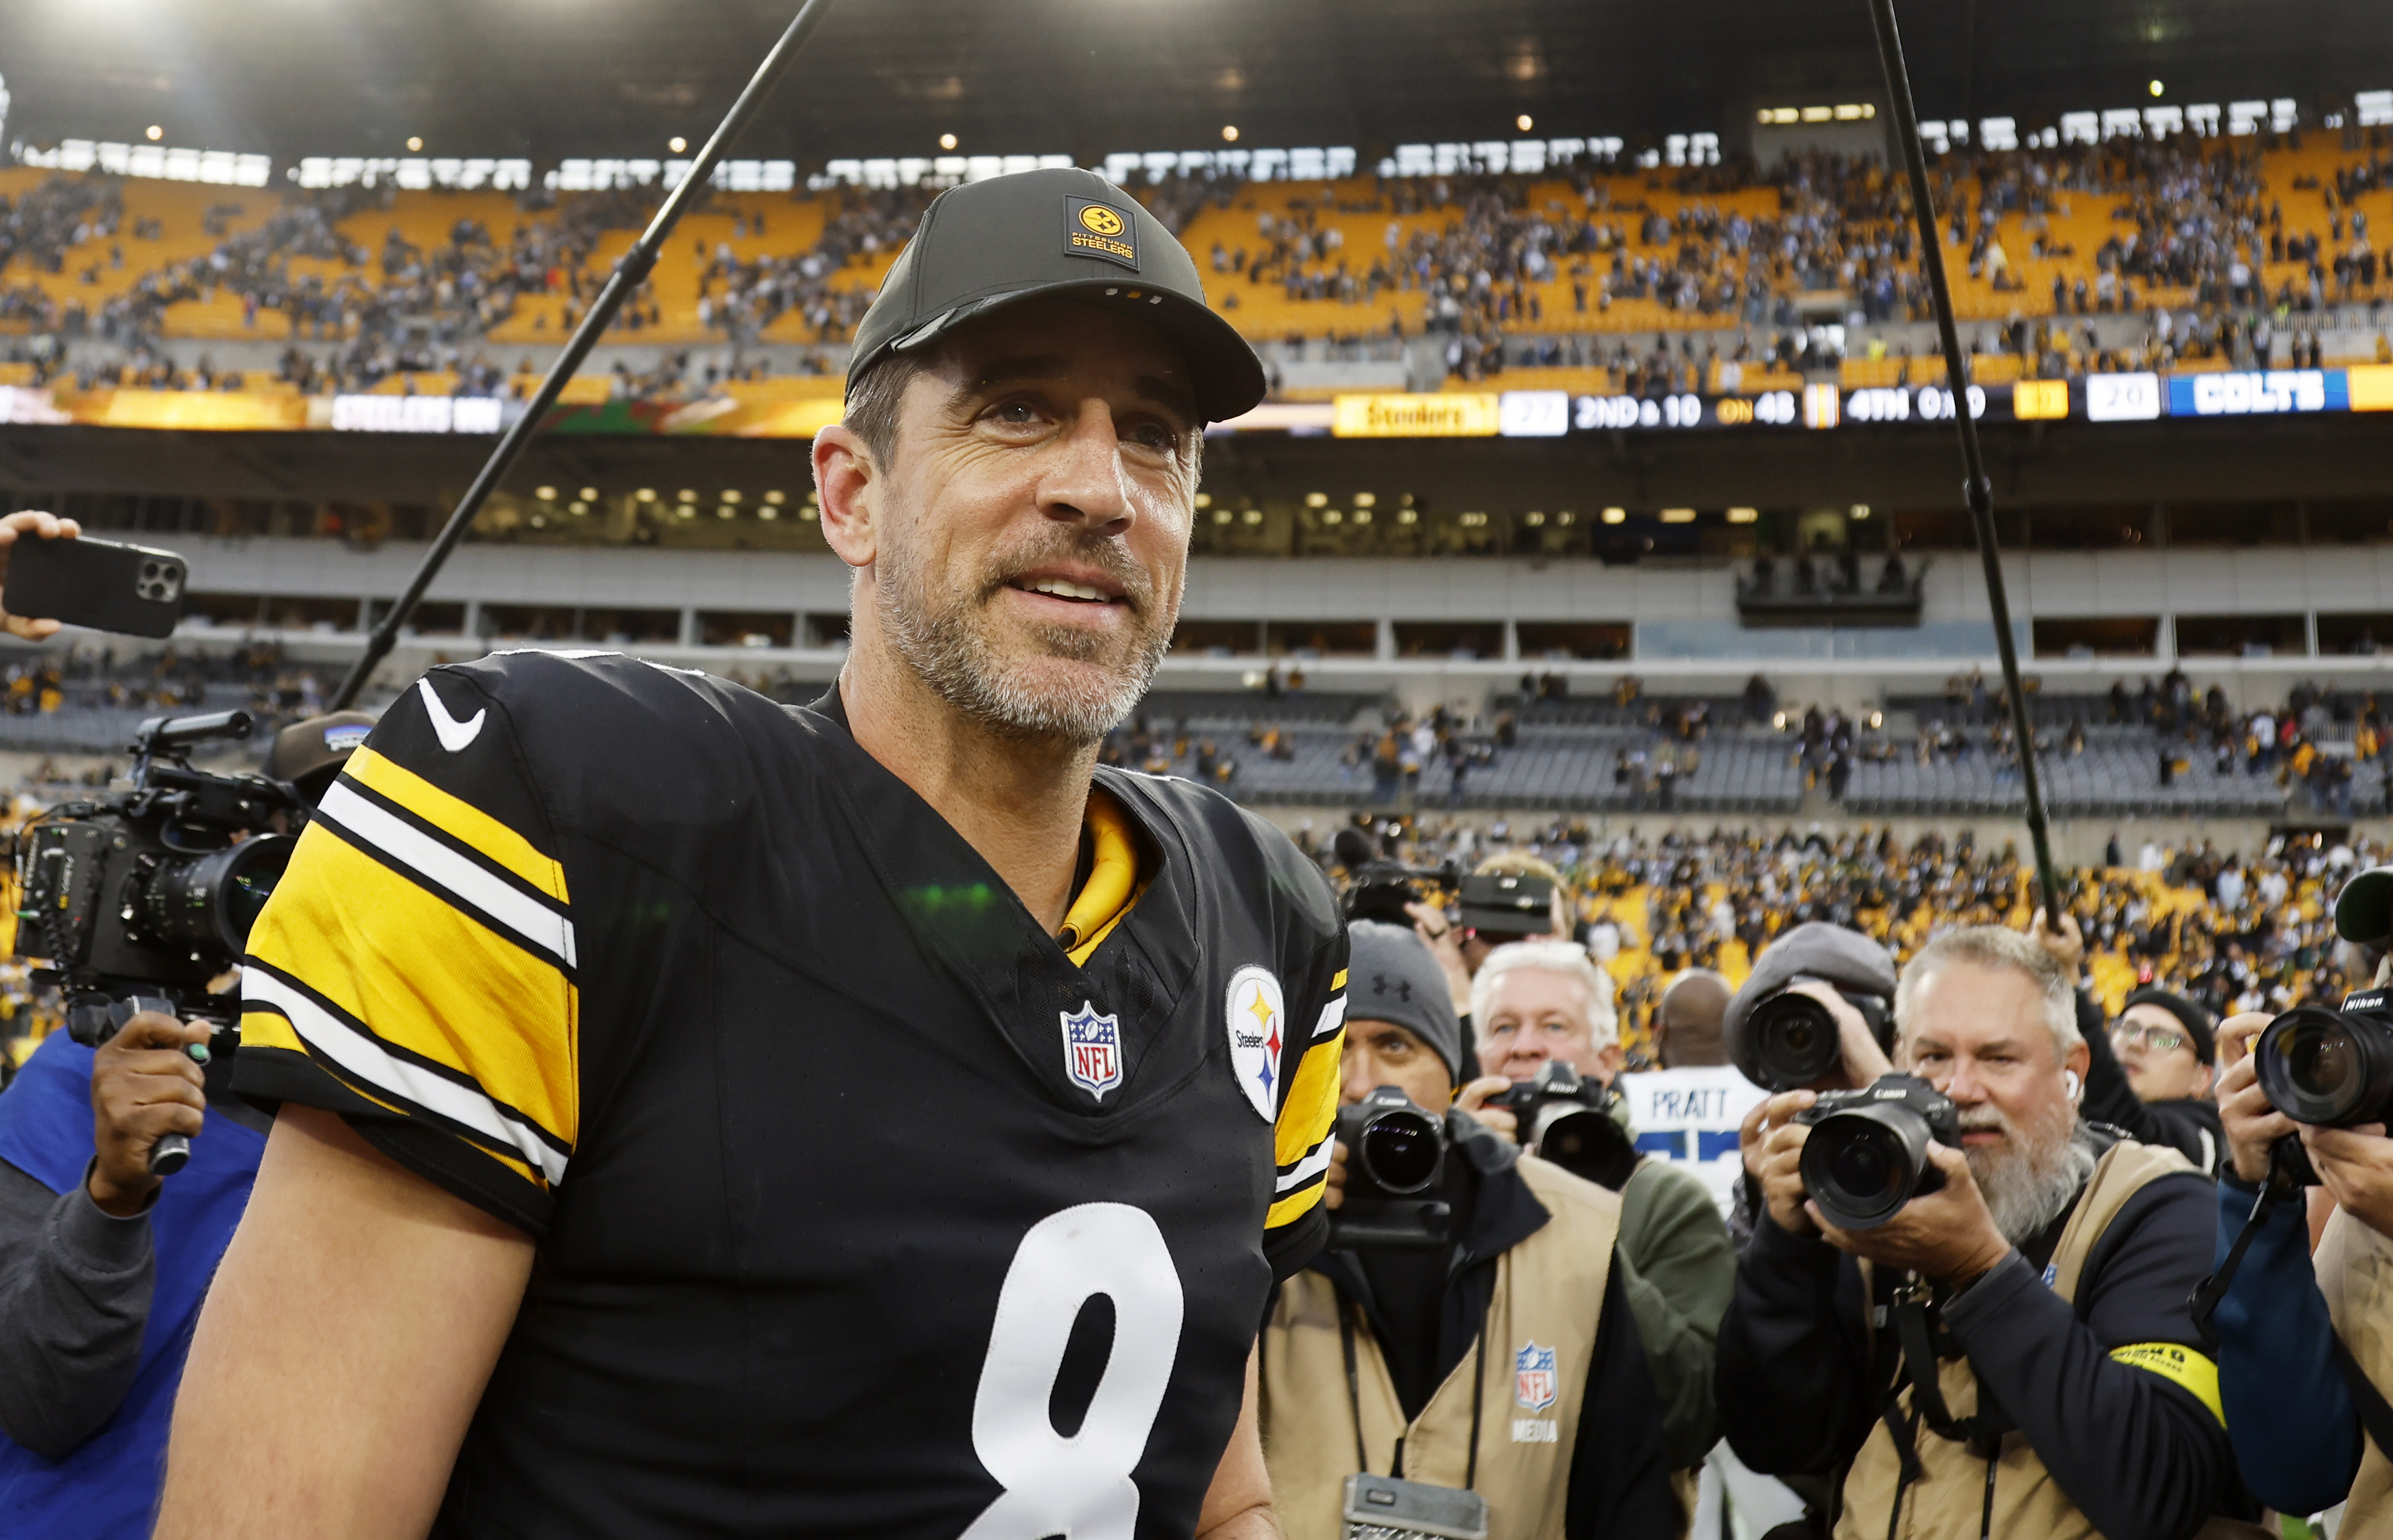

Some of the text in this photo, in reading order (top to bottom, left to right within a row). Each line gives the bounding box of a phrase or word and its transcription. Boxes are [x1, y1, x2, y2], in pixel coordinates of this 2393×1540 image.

[1072, 232, 1133, 250] PITTSBURGH
[1072, 237, 1134, 259] STEELERS
[1847, 387, 1910, 422] 4TH
[2193, 369, 2325, 415] COLTS
[1576, 394, 1639, 429] 2ND
[1663, 393, 1701, 427] 10
[1715, 397, 1753, 425] ON
[2345, 997, 2384, 1012] Nikon
[1236, 1029, 1265, 1049] Steelers
[1076, 1046, 1115, 1082] NFL
[1547, 1082, 1579, 1094] Nikon
[1873, 1088, 1907, 1100] Canon
[1652, 1088, 1729, 1119] PRATT
[956, 1201, 1185, 1540] 8
[1518, 1372, 1553, 1402] NFL
[1511, 1419, 1558, 1443] MEDIA
